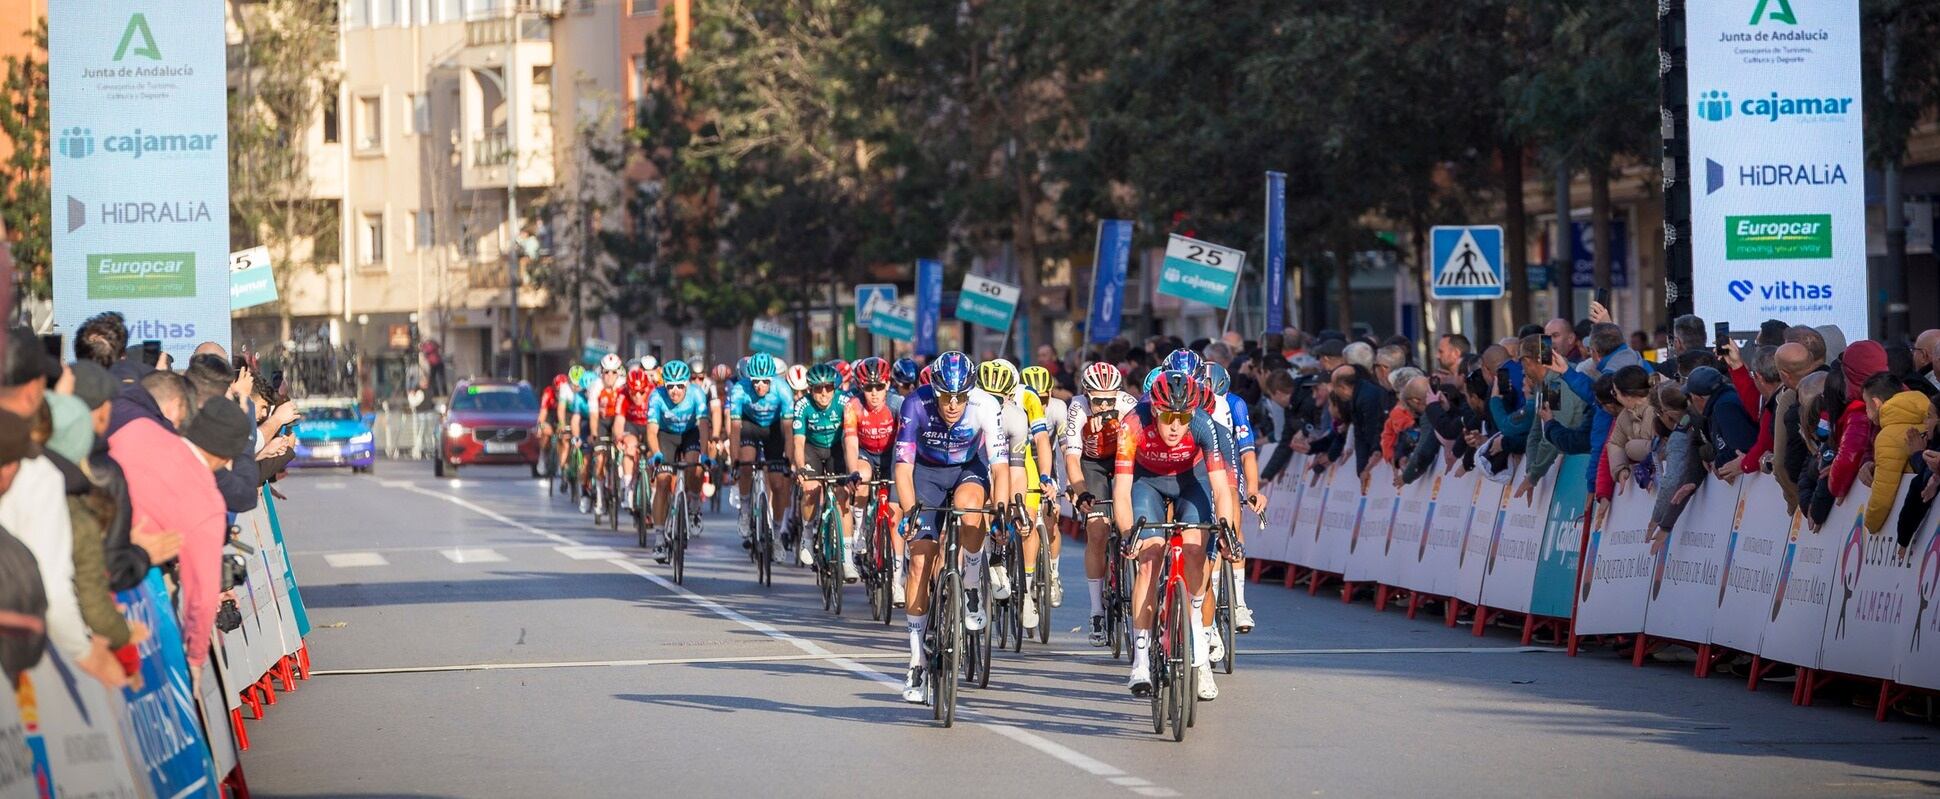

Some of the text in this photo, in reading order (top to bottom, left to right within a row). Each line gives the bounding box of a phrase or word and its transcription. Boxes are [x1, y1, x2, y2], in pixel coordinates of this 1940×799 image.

[1719, 28, 1829, 42] Junta de Andalucía
[82, 64, 194, 79] Junta de Andalucía
[1741, 91, 1853, 123] cajamar
[103, 128, 219, 160] cajamar
[1740, 164, 1848, 186] HiDRALiA
[101, 201, 213, 224] HiDRALiA
[1736, 219, 1821, 240] Europcar
[229, 253, 252, 271] 5
[1186, 244, 1222, 266] 25
[98, 258, 185, 278] Europcar
[230, 279, 268, 297] ajamar
[979, 281, 1002, 296] 50
[1761, 280, 1832, 300] vithas
[127, 319, 196, 339] vithas
[1066, 403, 1083, 437] Cofidis
[862, 426, 893, 437] INEOS
[1146, 450, 1191, 460] INEOS
[1866, 535, 1898, 568] COSTA
[1856, 582, 1904, 625] ALMERÍA
